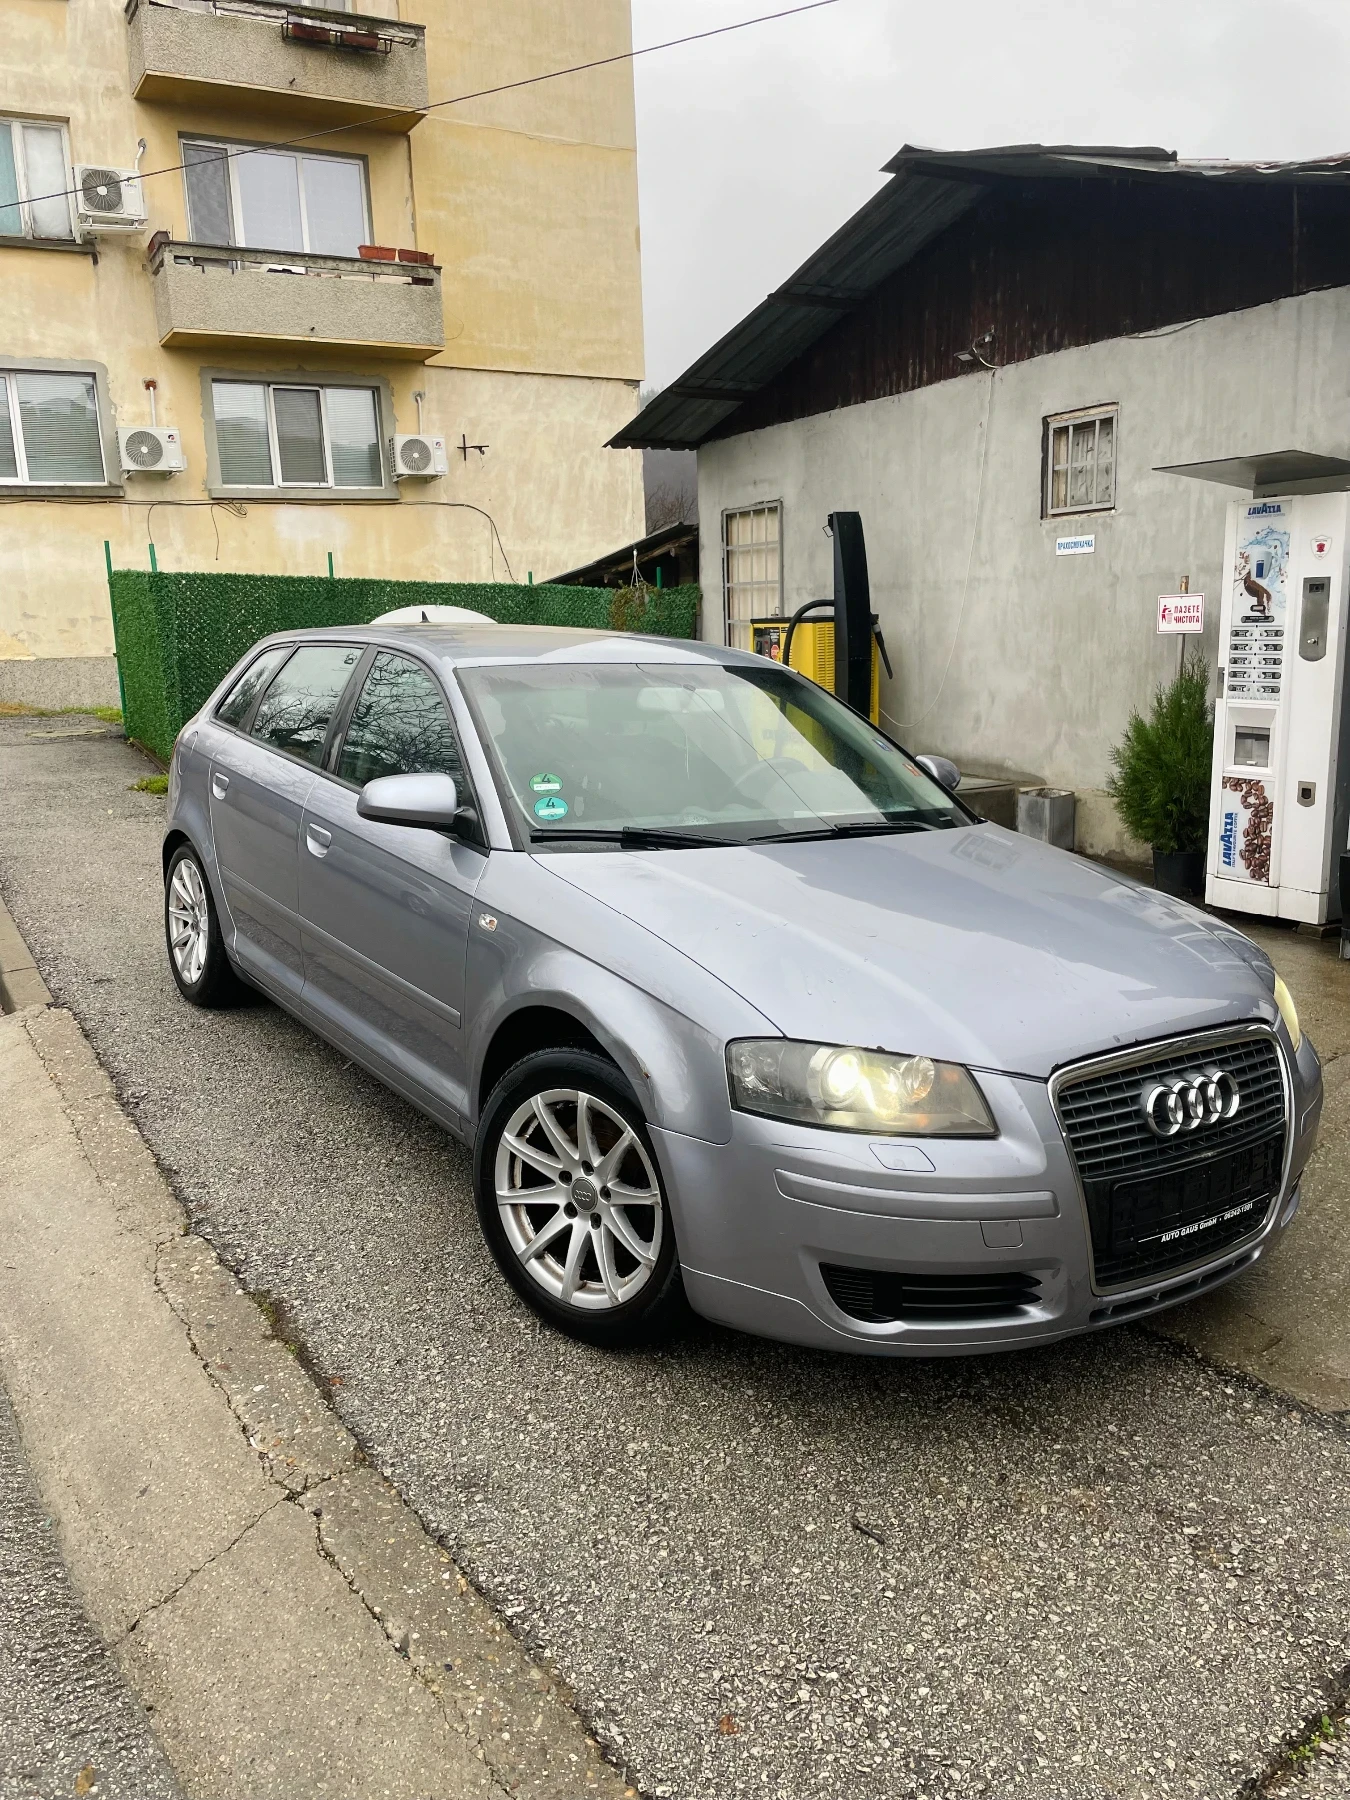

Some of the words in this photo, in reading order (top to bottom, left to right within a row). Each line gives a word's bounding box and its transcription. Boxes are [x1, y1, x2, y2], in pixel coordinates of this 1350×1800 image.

[1248, 503, 1281, 515] LAVAZZA
[1174, 605, 1200, 614] ПАЗЕТЕ
[1174, 615, 1200, 624] ЧИСТОТА
[542, 774, 551, 783] 4
[546, 798, 555, 808] 4
[1221, 813, 1233, 866] LAVAZZA
[1161, 1231, 1180, 1242] AUTO
[1181, 1225, 1198, 1236] GAUS
[1199, 1218, 1217, 1229] GmbH
